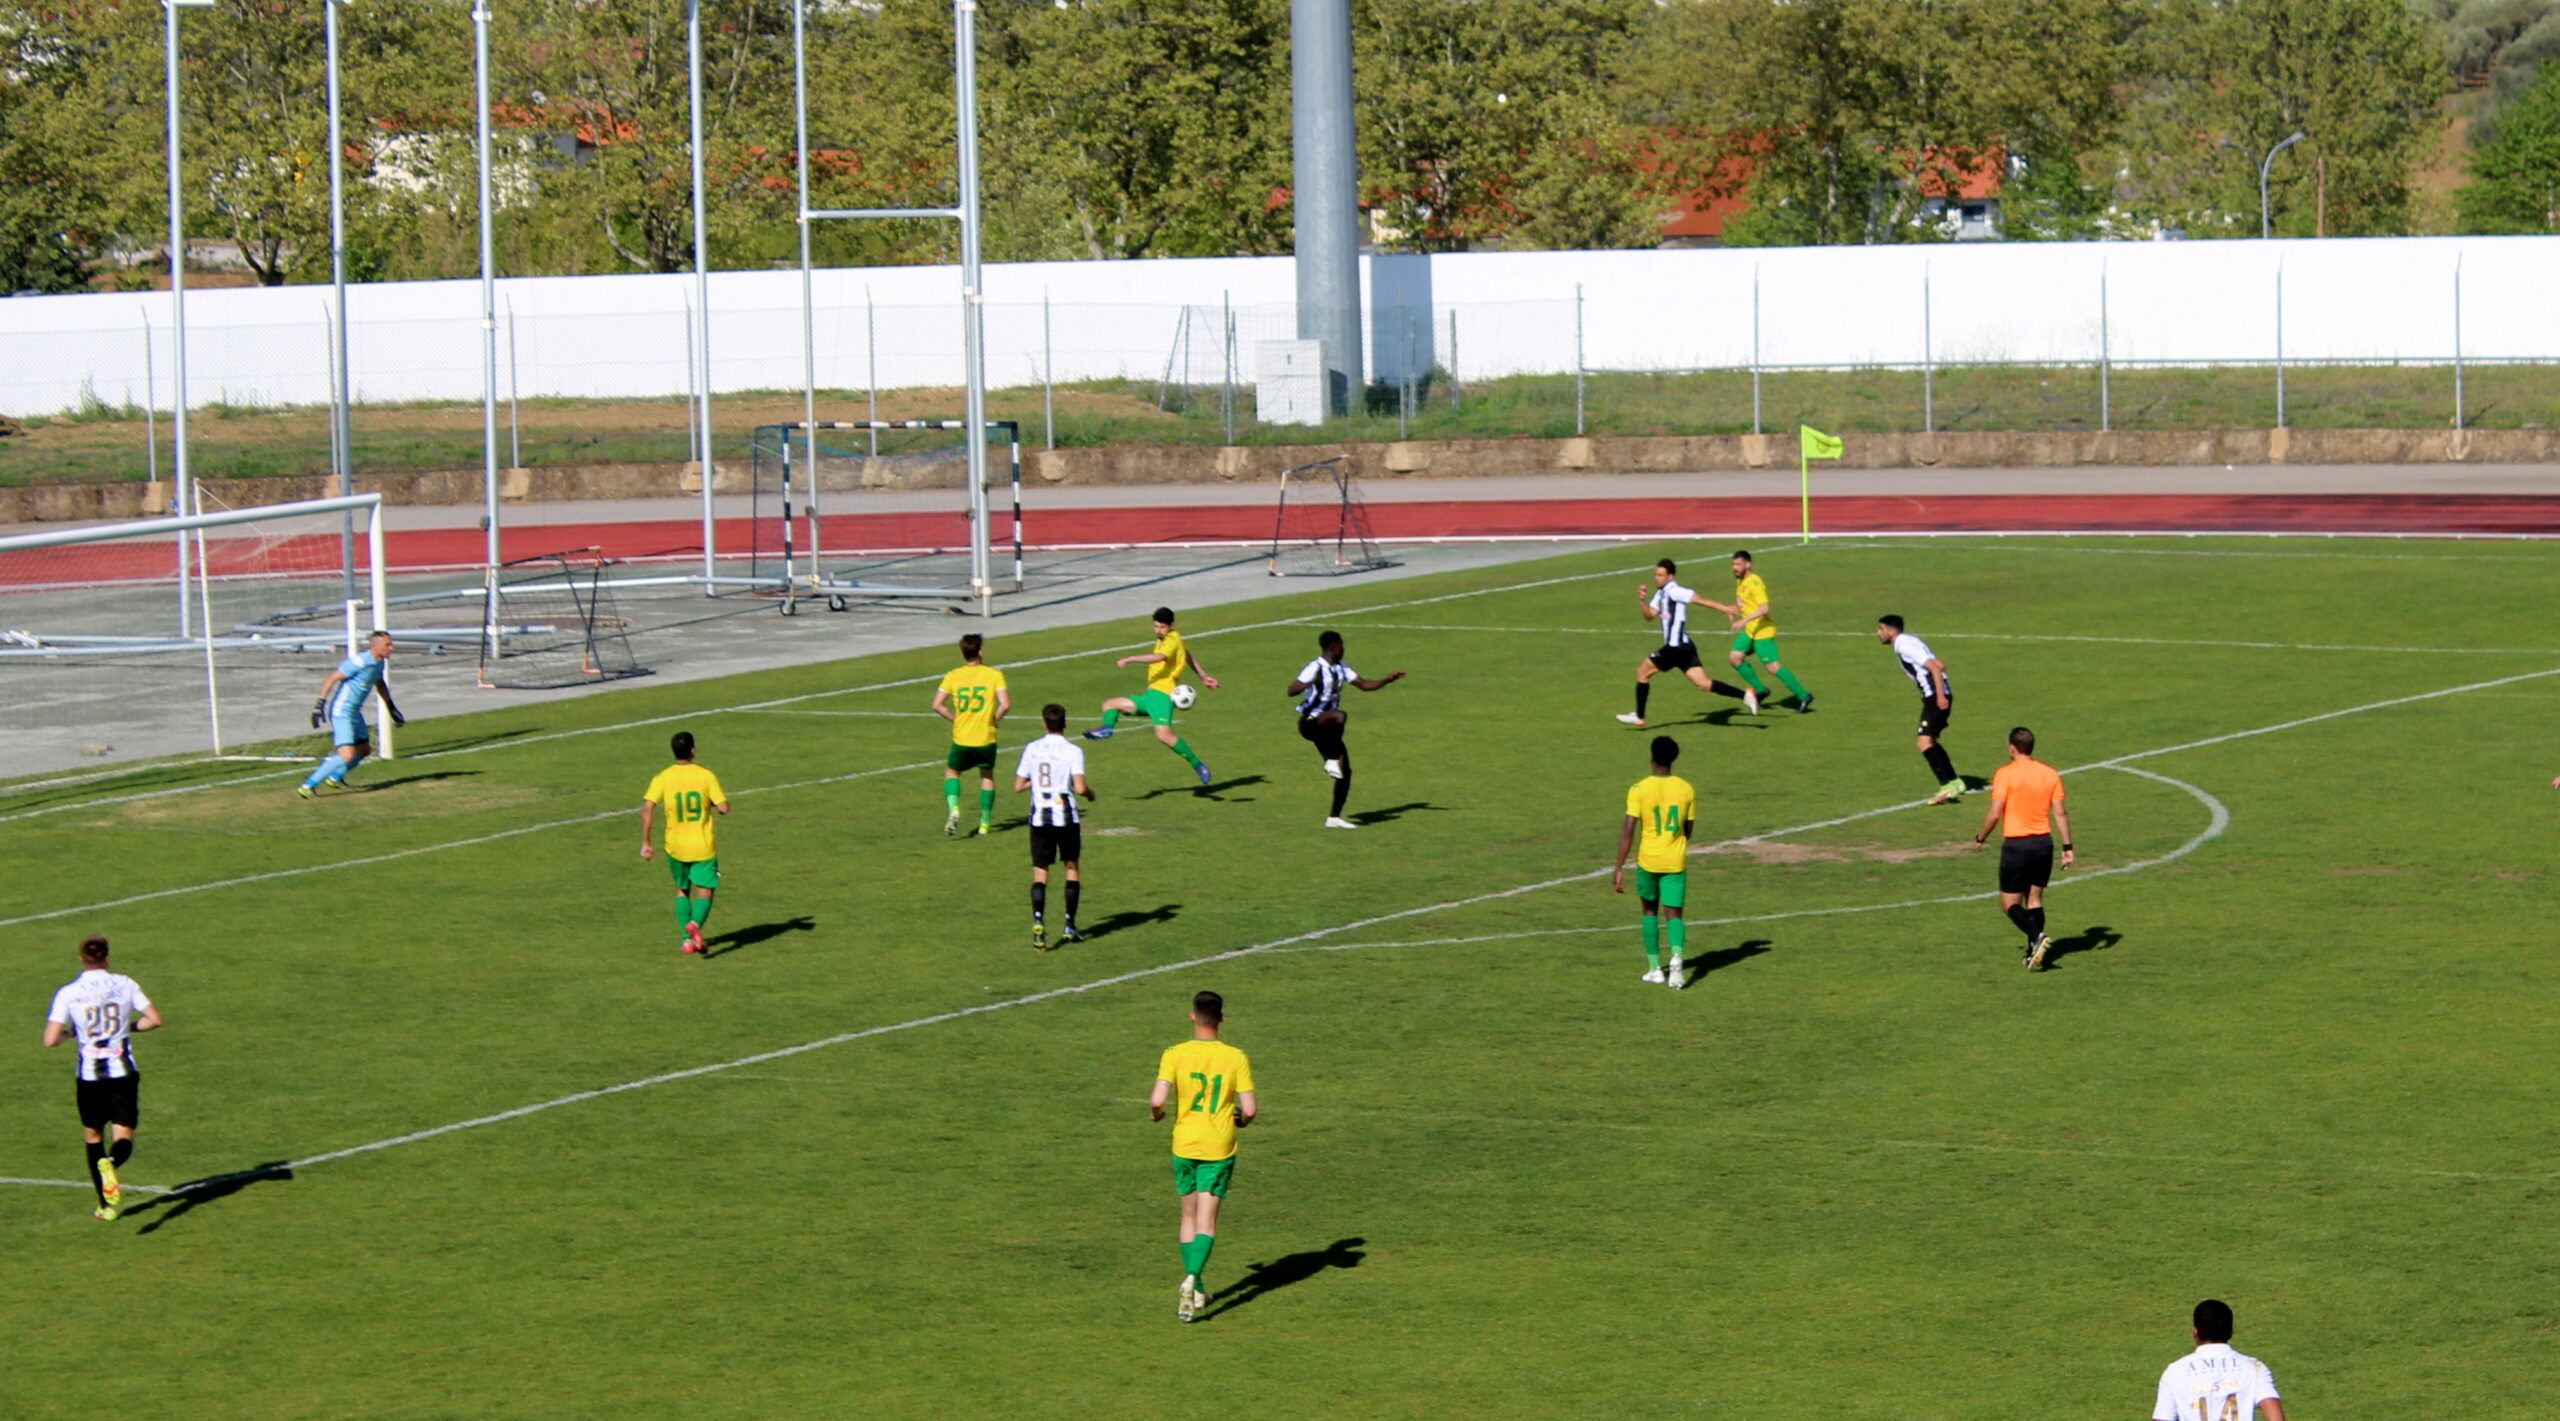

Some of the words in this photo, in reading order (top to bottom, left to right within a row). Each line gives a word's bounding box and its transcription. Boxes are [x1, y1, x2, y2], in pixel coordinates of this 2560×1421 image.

[1038, 762, 1052, 788] 8
[674, 790, 702, 824] 19
[1653, 804, 1680, 838] 14
[85, 1003, 121, 1038] 28
[1190, 1071, 1222, 1115] 21
